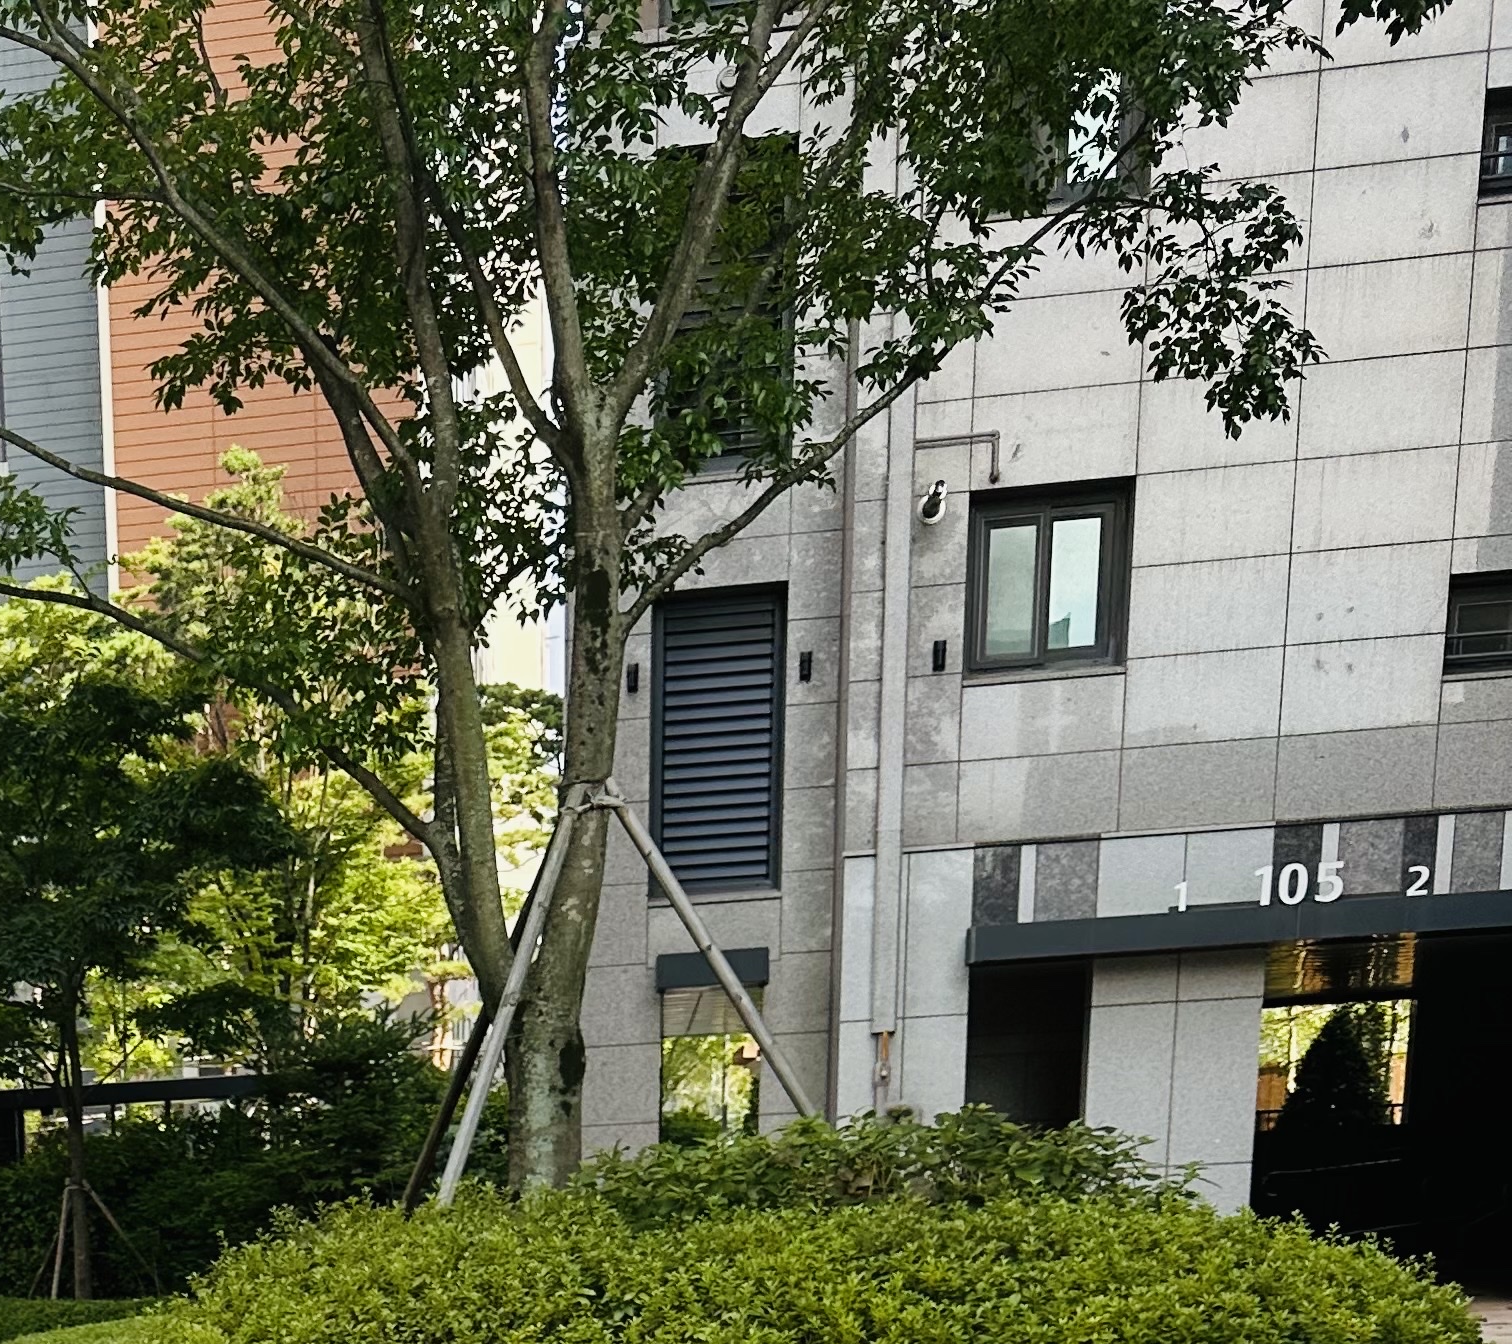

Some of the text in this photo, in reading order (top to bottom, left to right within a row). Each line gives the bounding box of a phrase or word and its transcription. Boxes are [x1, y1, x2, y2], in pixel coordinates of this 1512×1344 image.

[1174, 860, 1430, 912] 1 105 2
